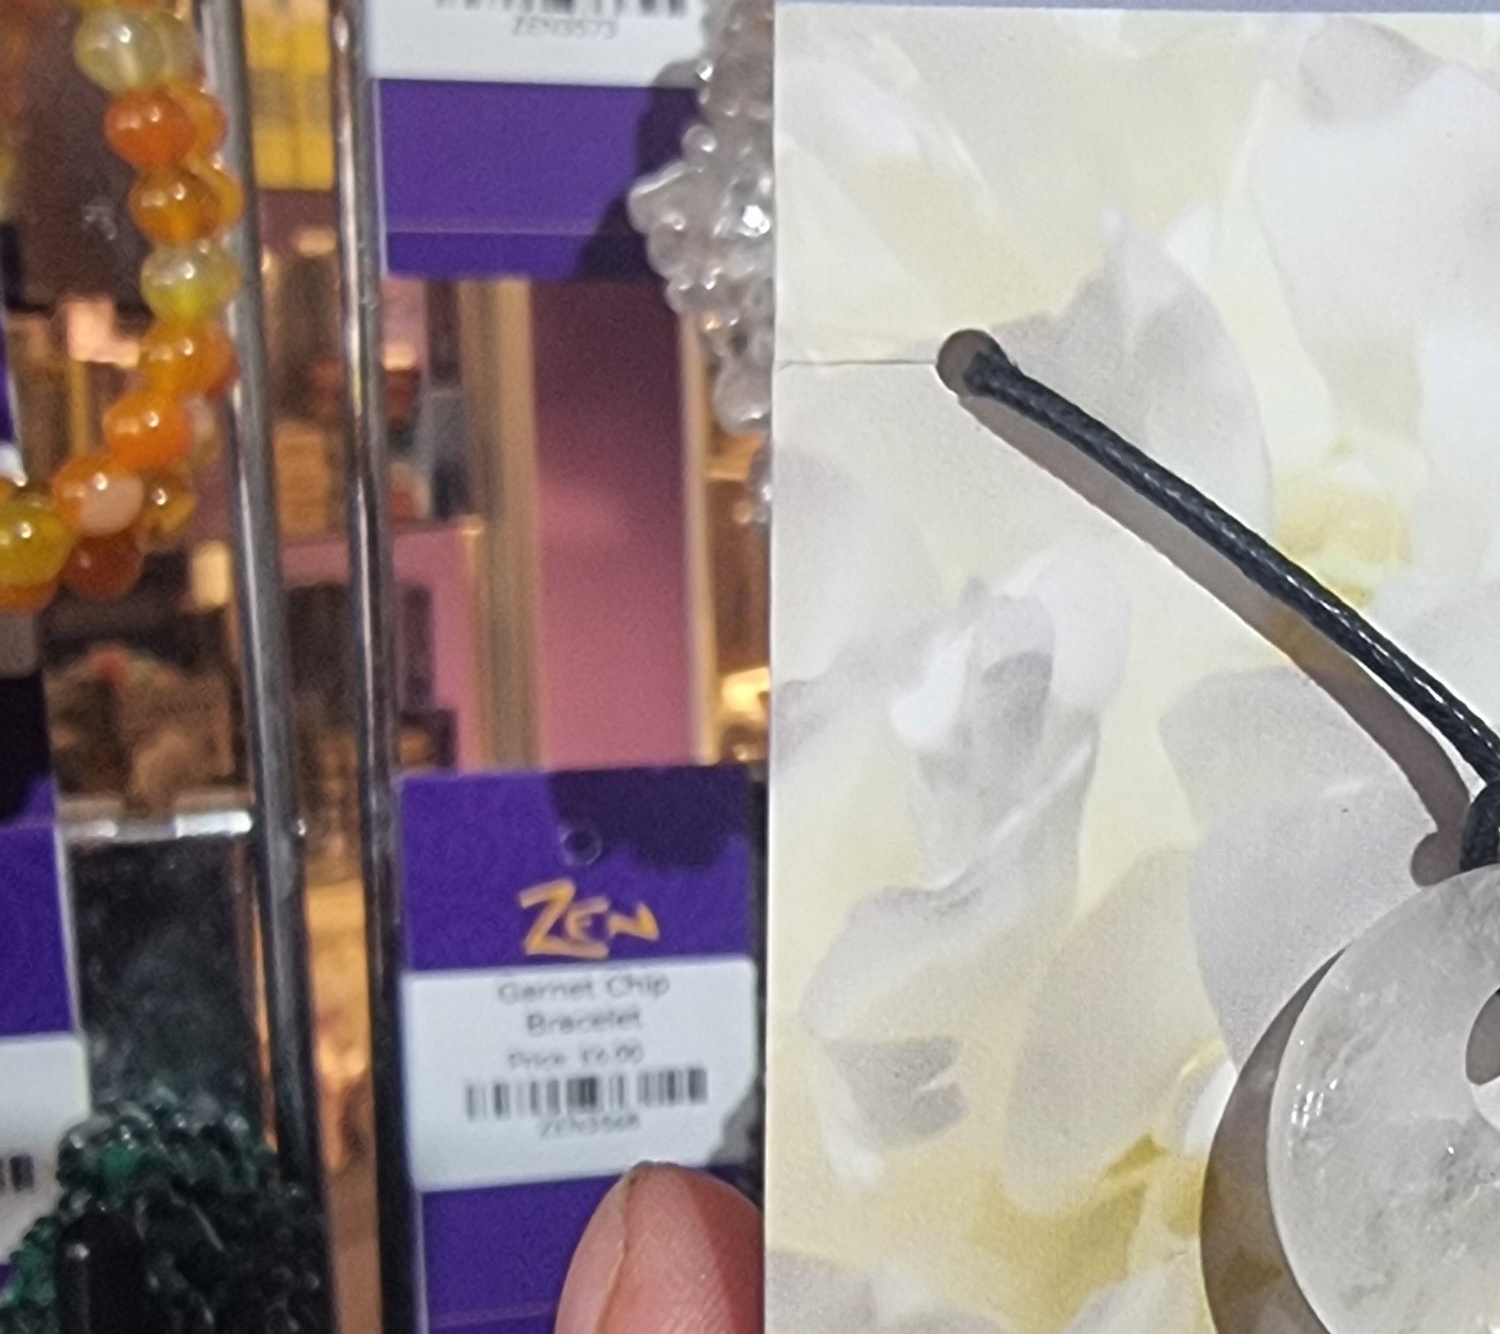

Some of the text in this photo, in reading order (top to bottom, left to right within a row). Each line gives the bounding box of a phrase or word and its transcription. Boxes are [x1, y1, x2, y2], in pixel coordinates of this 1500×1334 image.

[518, 878, 660, 960] ZEN
[498, 972, 671, 1006] Garnet Chip
[526, 1009, 641, 1037] Bracelet
